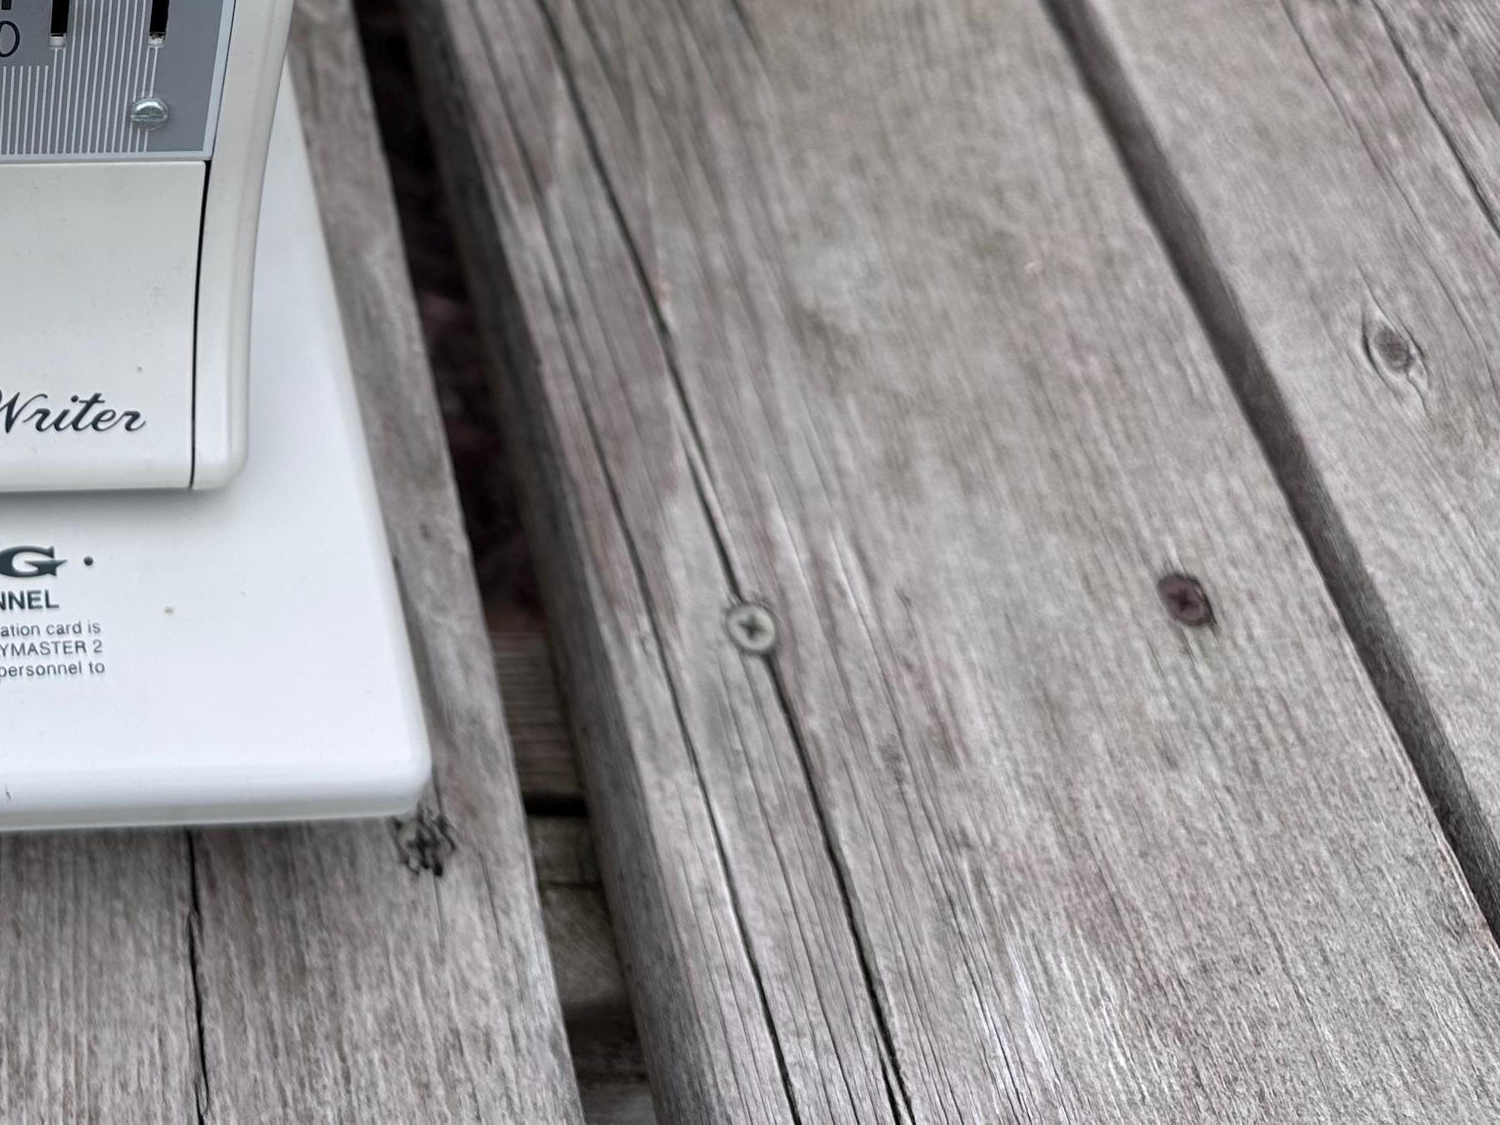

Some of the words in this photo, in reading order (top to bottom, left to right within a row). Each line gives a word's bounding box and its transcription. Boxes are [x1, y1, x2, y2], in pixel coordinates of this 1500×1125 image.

[46, 621, 82, 635] card
[87, 620, 101, 634] is
[93, 639, 103, 653] 2
[89, 661, 105, 674] to
